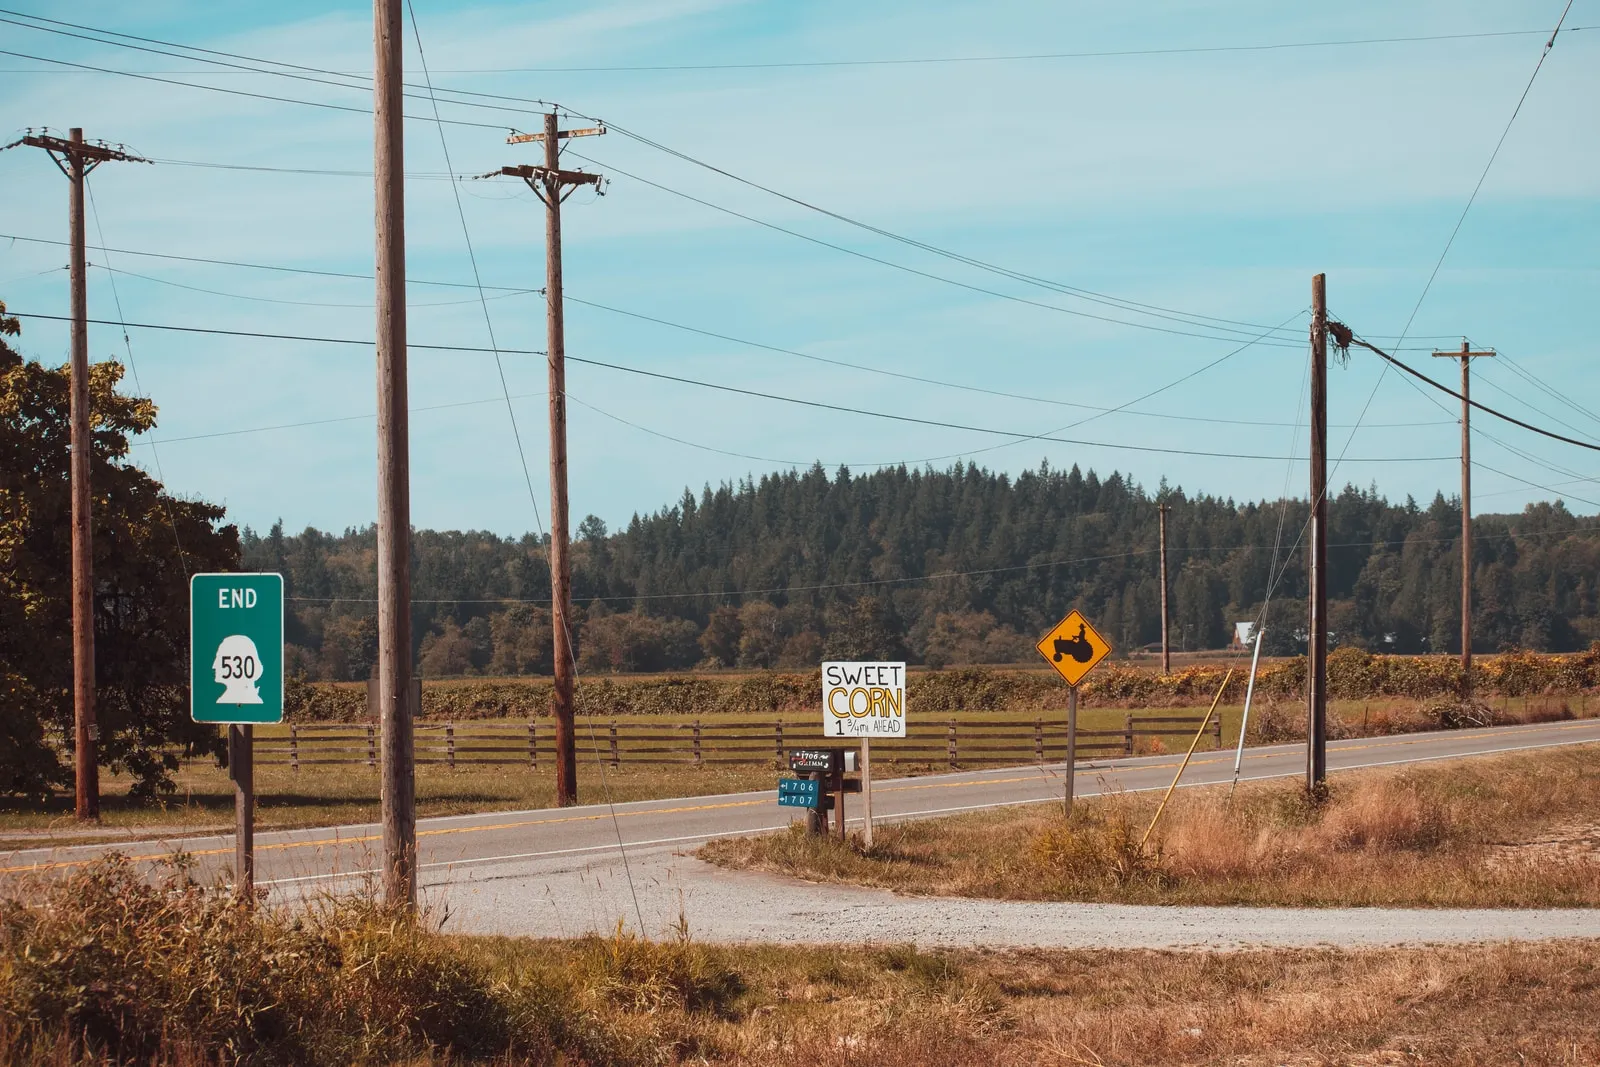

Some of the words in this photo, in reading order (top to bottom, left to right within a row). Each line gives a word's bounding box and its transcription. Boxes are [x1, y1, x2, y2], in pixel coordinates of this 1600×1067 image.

[218, 588, 257, 609] END
[222, 655, 255, 679] 530
[827, 666, 902, 686] SWEET
[828, 687, 902, 718] CORN
[835, 720, 845, 735] 1
[873, 720, 901, 733] AHEAD
[801, 752, 819, 760] 1706
[785, 782, 814, 792] 1706
[784, 795, 813, 805] 1707
